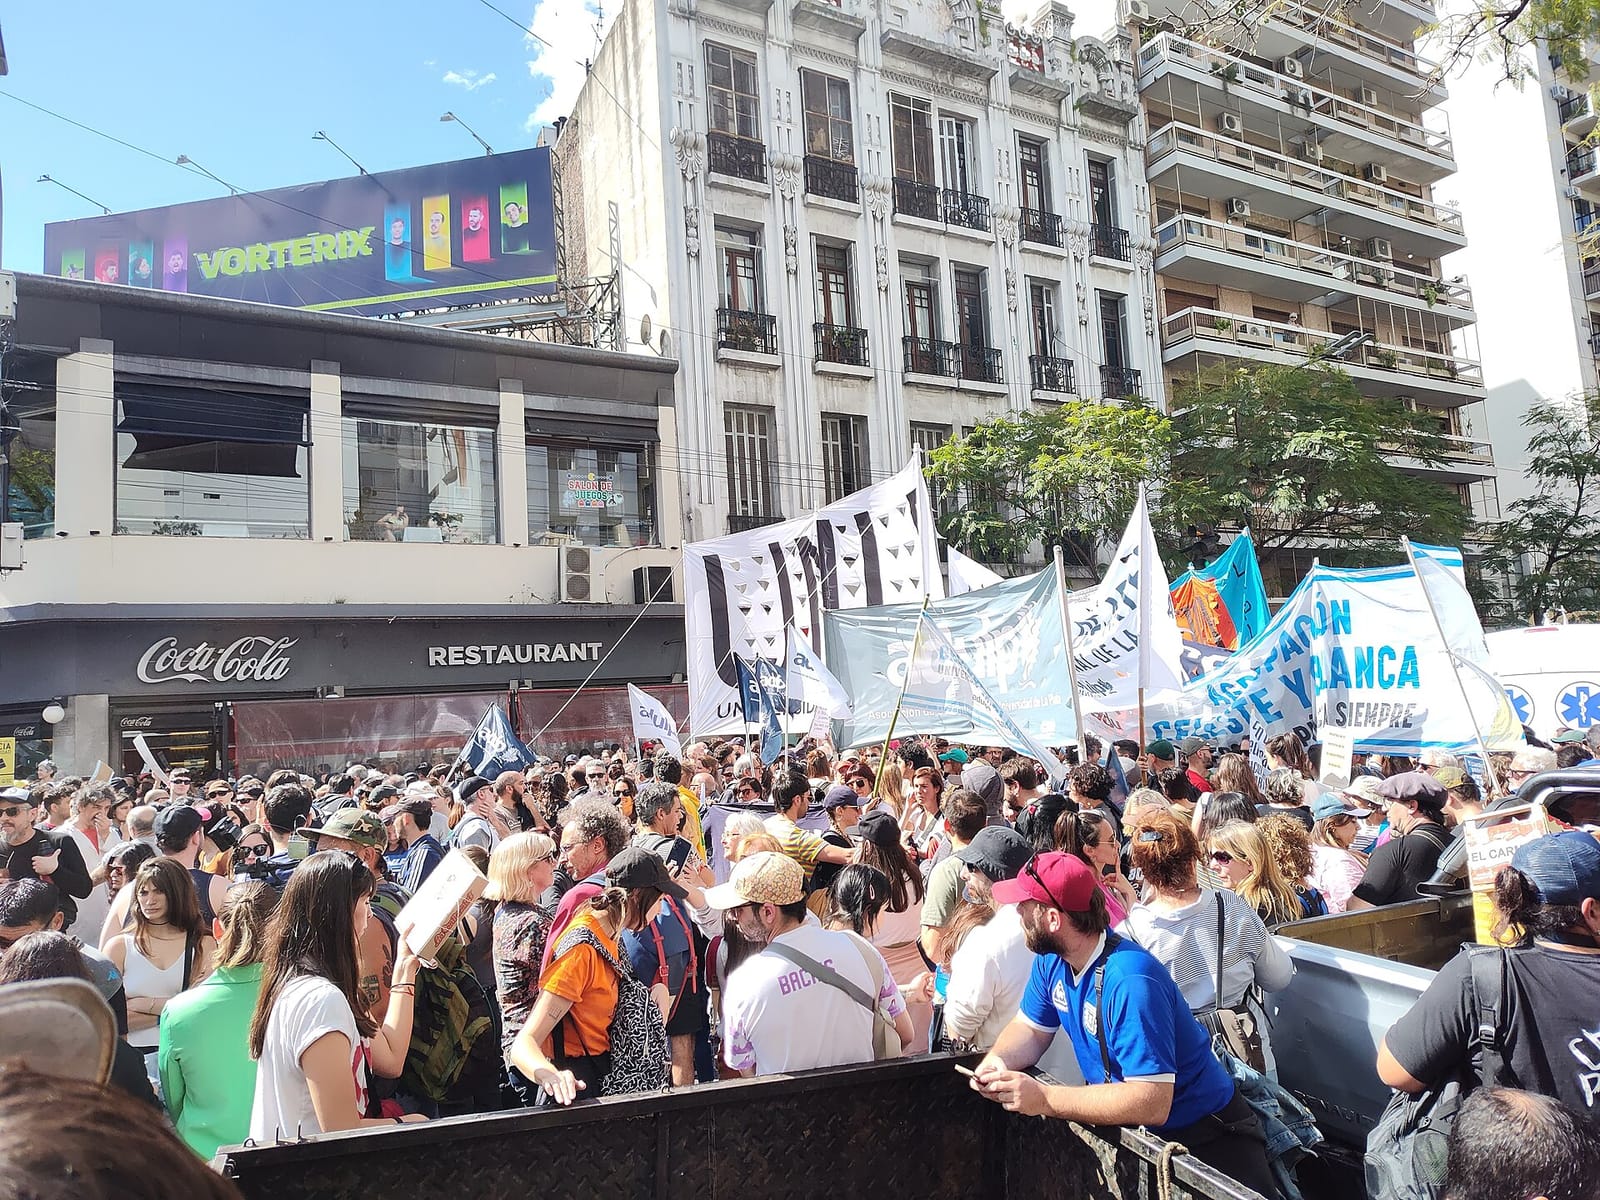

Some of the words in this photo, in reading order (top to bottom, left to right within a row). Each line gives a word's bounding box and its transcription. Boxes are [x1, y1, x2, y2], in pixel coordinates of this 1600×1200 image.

[193, 226, 376, 279] VORTERIX
[569, 481, 598, 490] SALON
[601, 482, 612, 490] DE
[575, 491, 607, 500] JUEGOS
[136, 636, 300, 684] Coca-Cola
[428, 642, 603, 666] RESTAURANT
[1278, 667, 1312, 709] Y
[1335, 701, 1417, 729] SIEMPRE
[1471, 850, 1487, 862] EL
